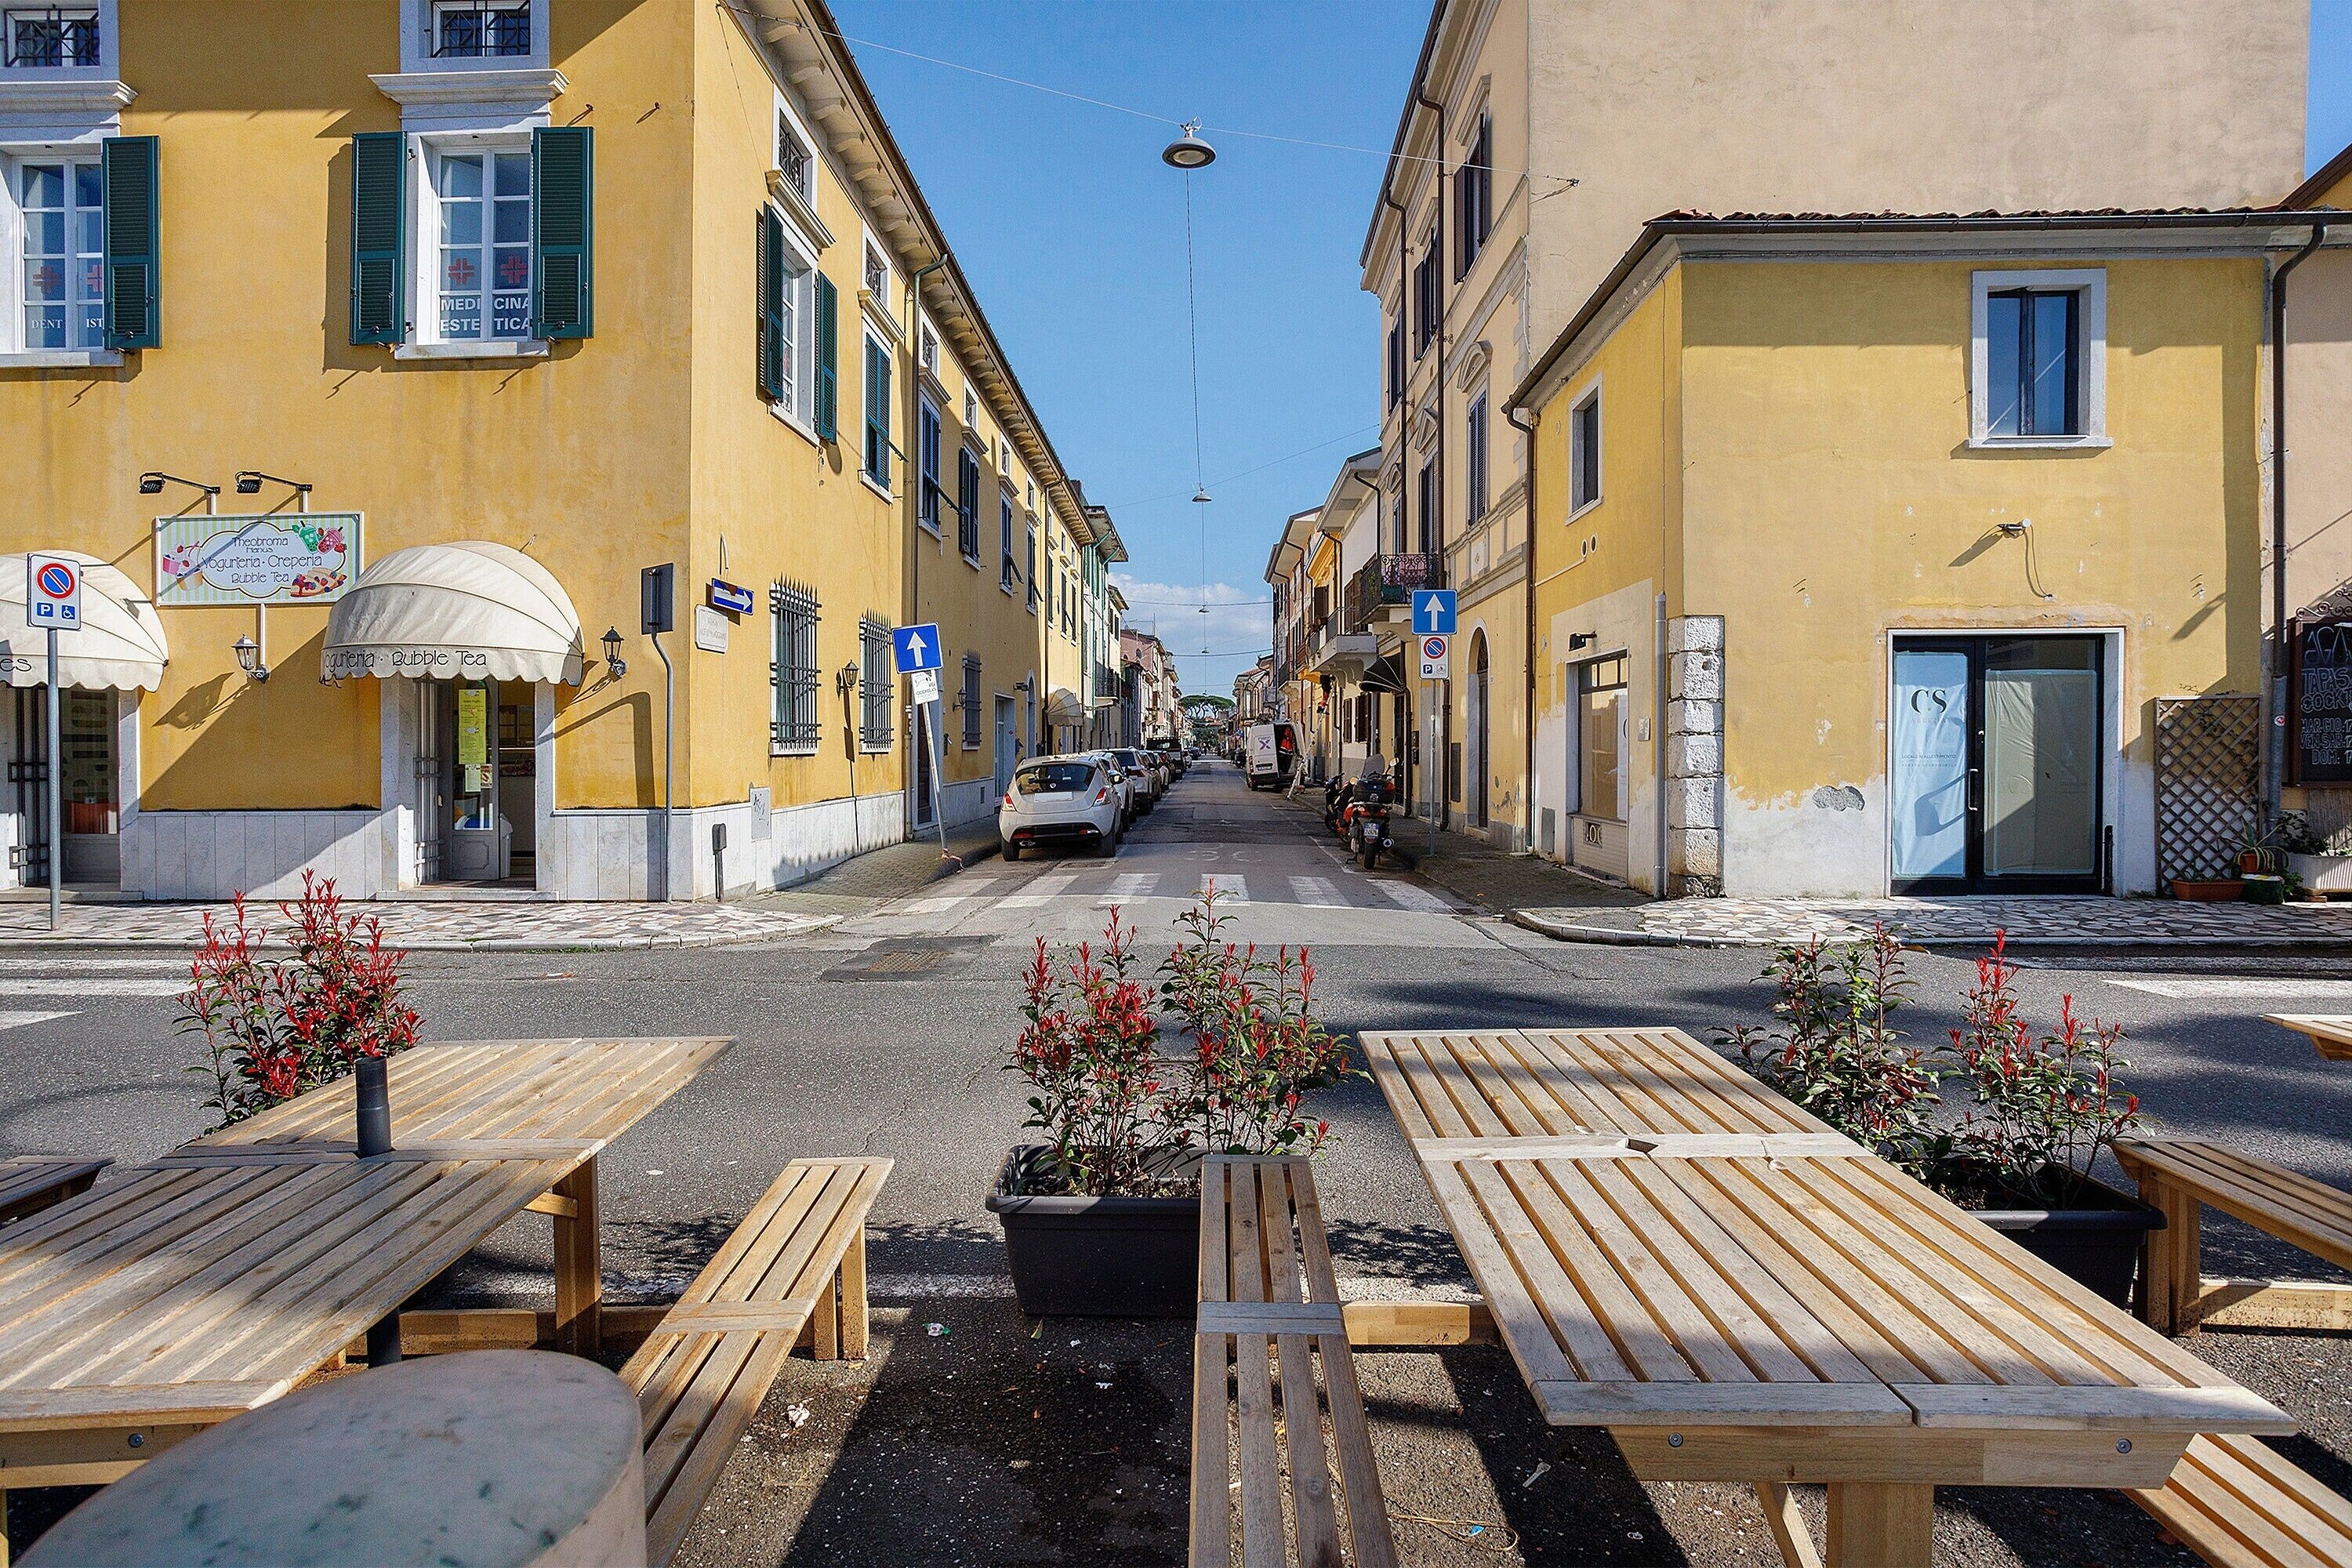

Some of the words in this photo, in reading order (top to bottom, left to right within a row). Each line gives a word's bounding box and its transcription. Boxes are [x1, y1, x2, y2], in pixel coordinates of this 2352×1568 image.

[232, 537, 289, 547] Theobroma
[201, 556, 260, 572] Yogurteria
[267, 555, 322, 569] Creperia
[231, 573, 267, 583] Bubble
[270, 572, 289, 583] Tea
[392, 650, 448, 666] Bubble
[456, 650, 487, 666] Tea
